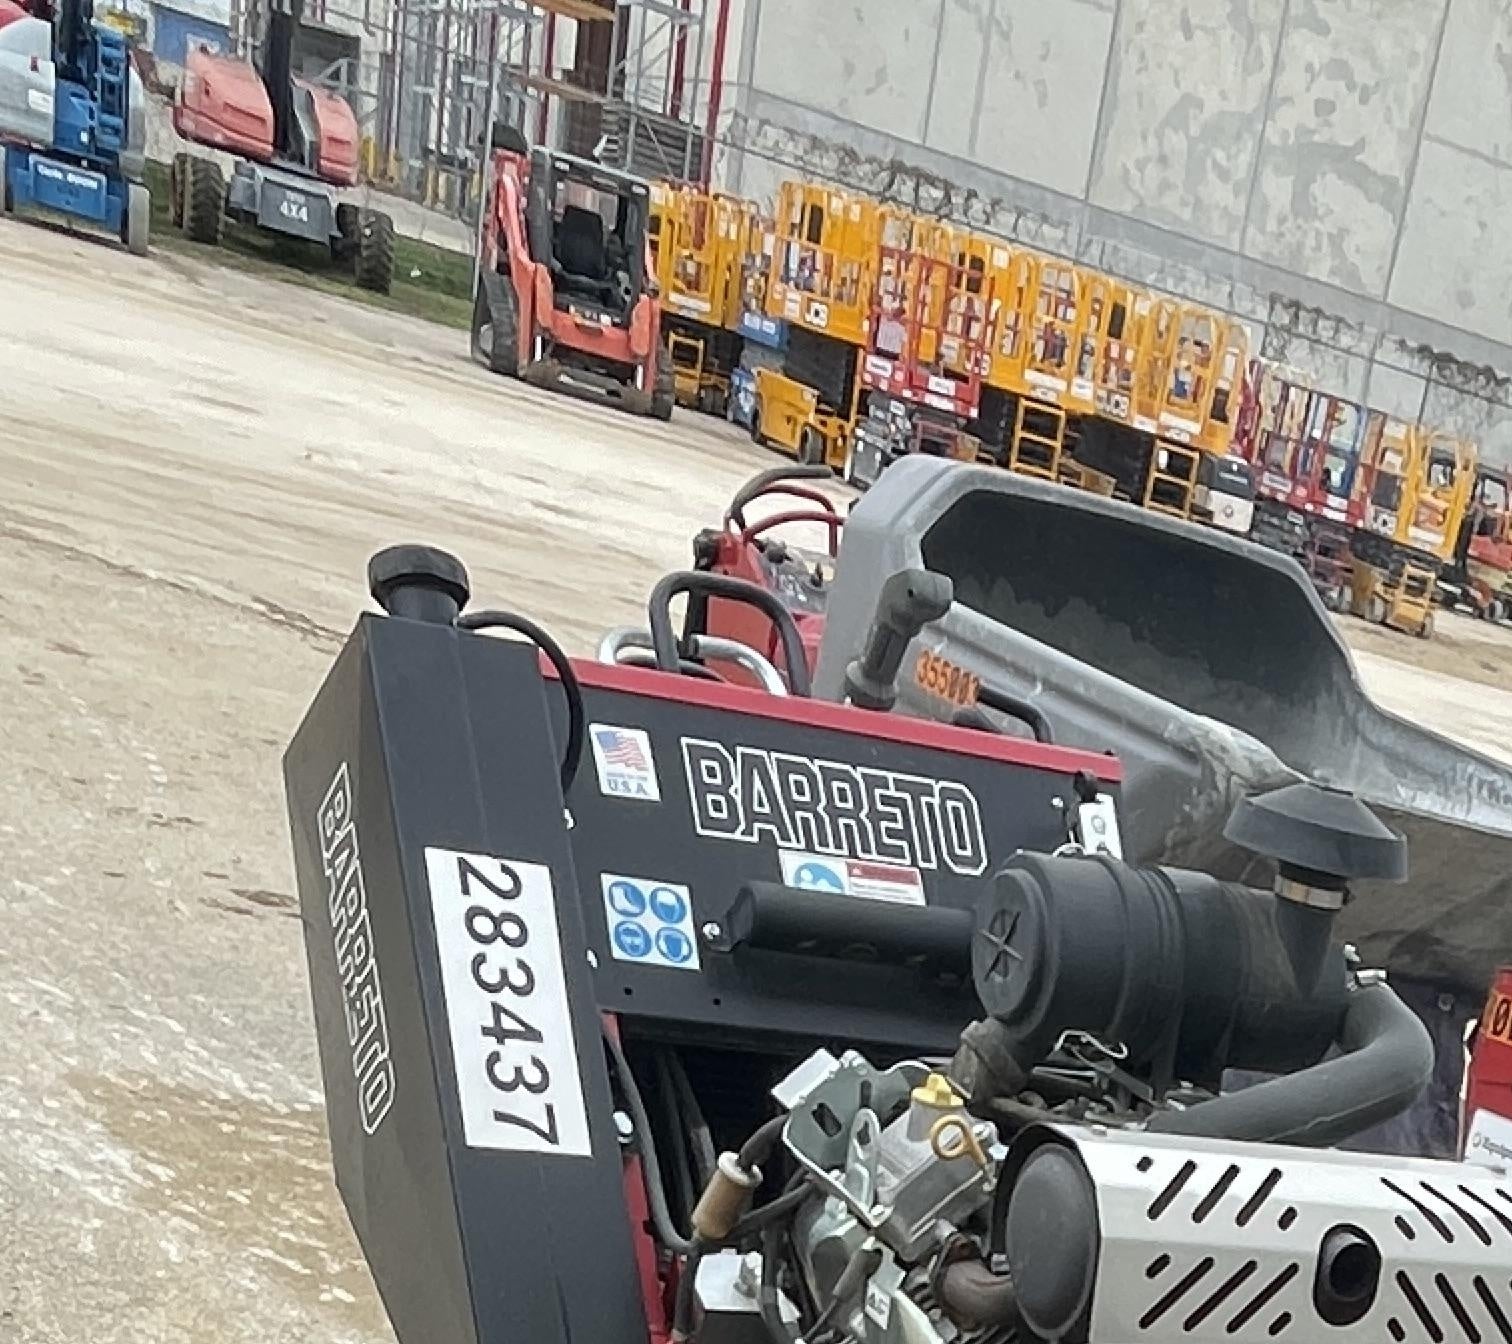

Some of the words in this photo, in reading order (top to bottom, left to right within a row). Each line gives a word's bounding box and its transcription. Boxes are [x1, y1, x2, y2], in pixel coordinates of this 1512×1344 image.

[317, 761, 397, 1136] BARRETO
[680, 737, 988, 876] BARRETO
[456, 855, 560, 1145] 283437
